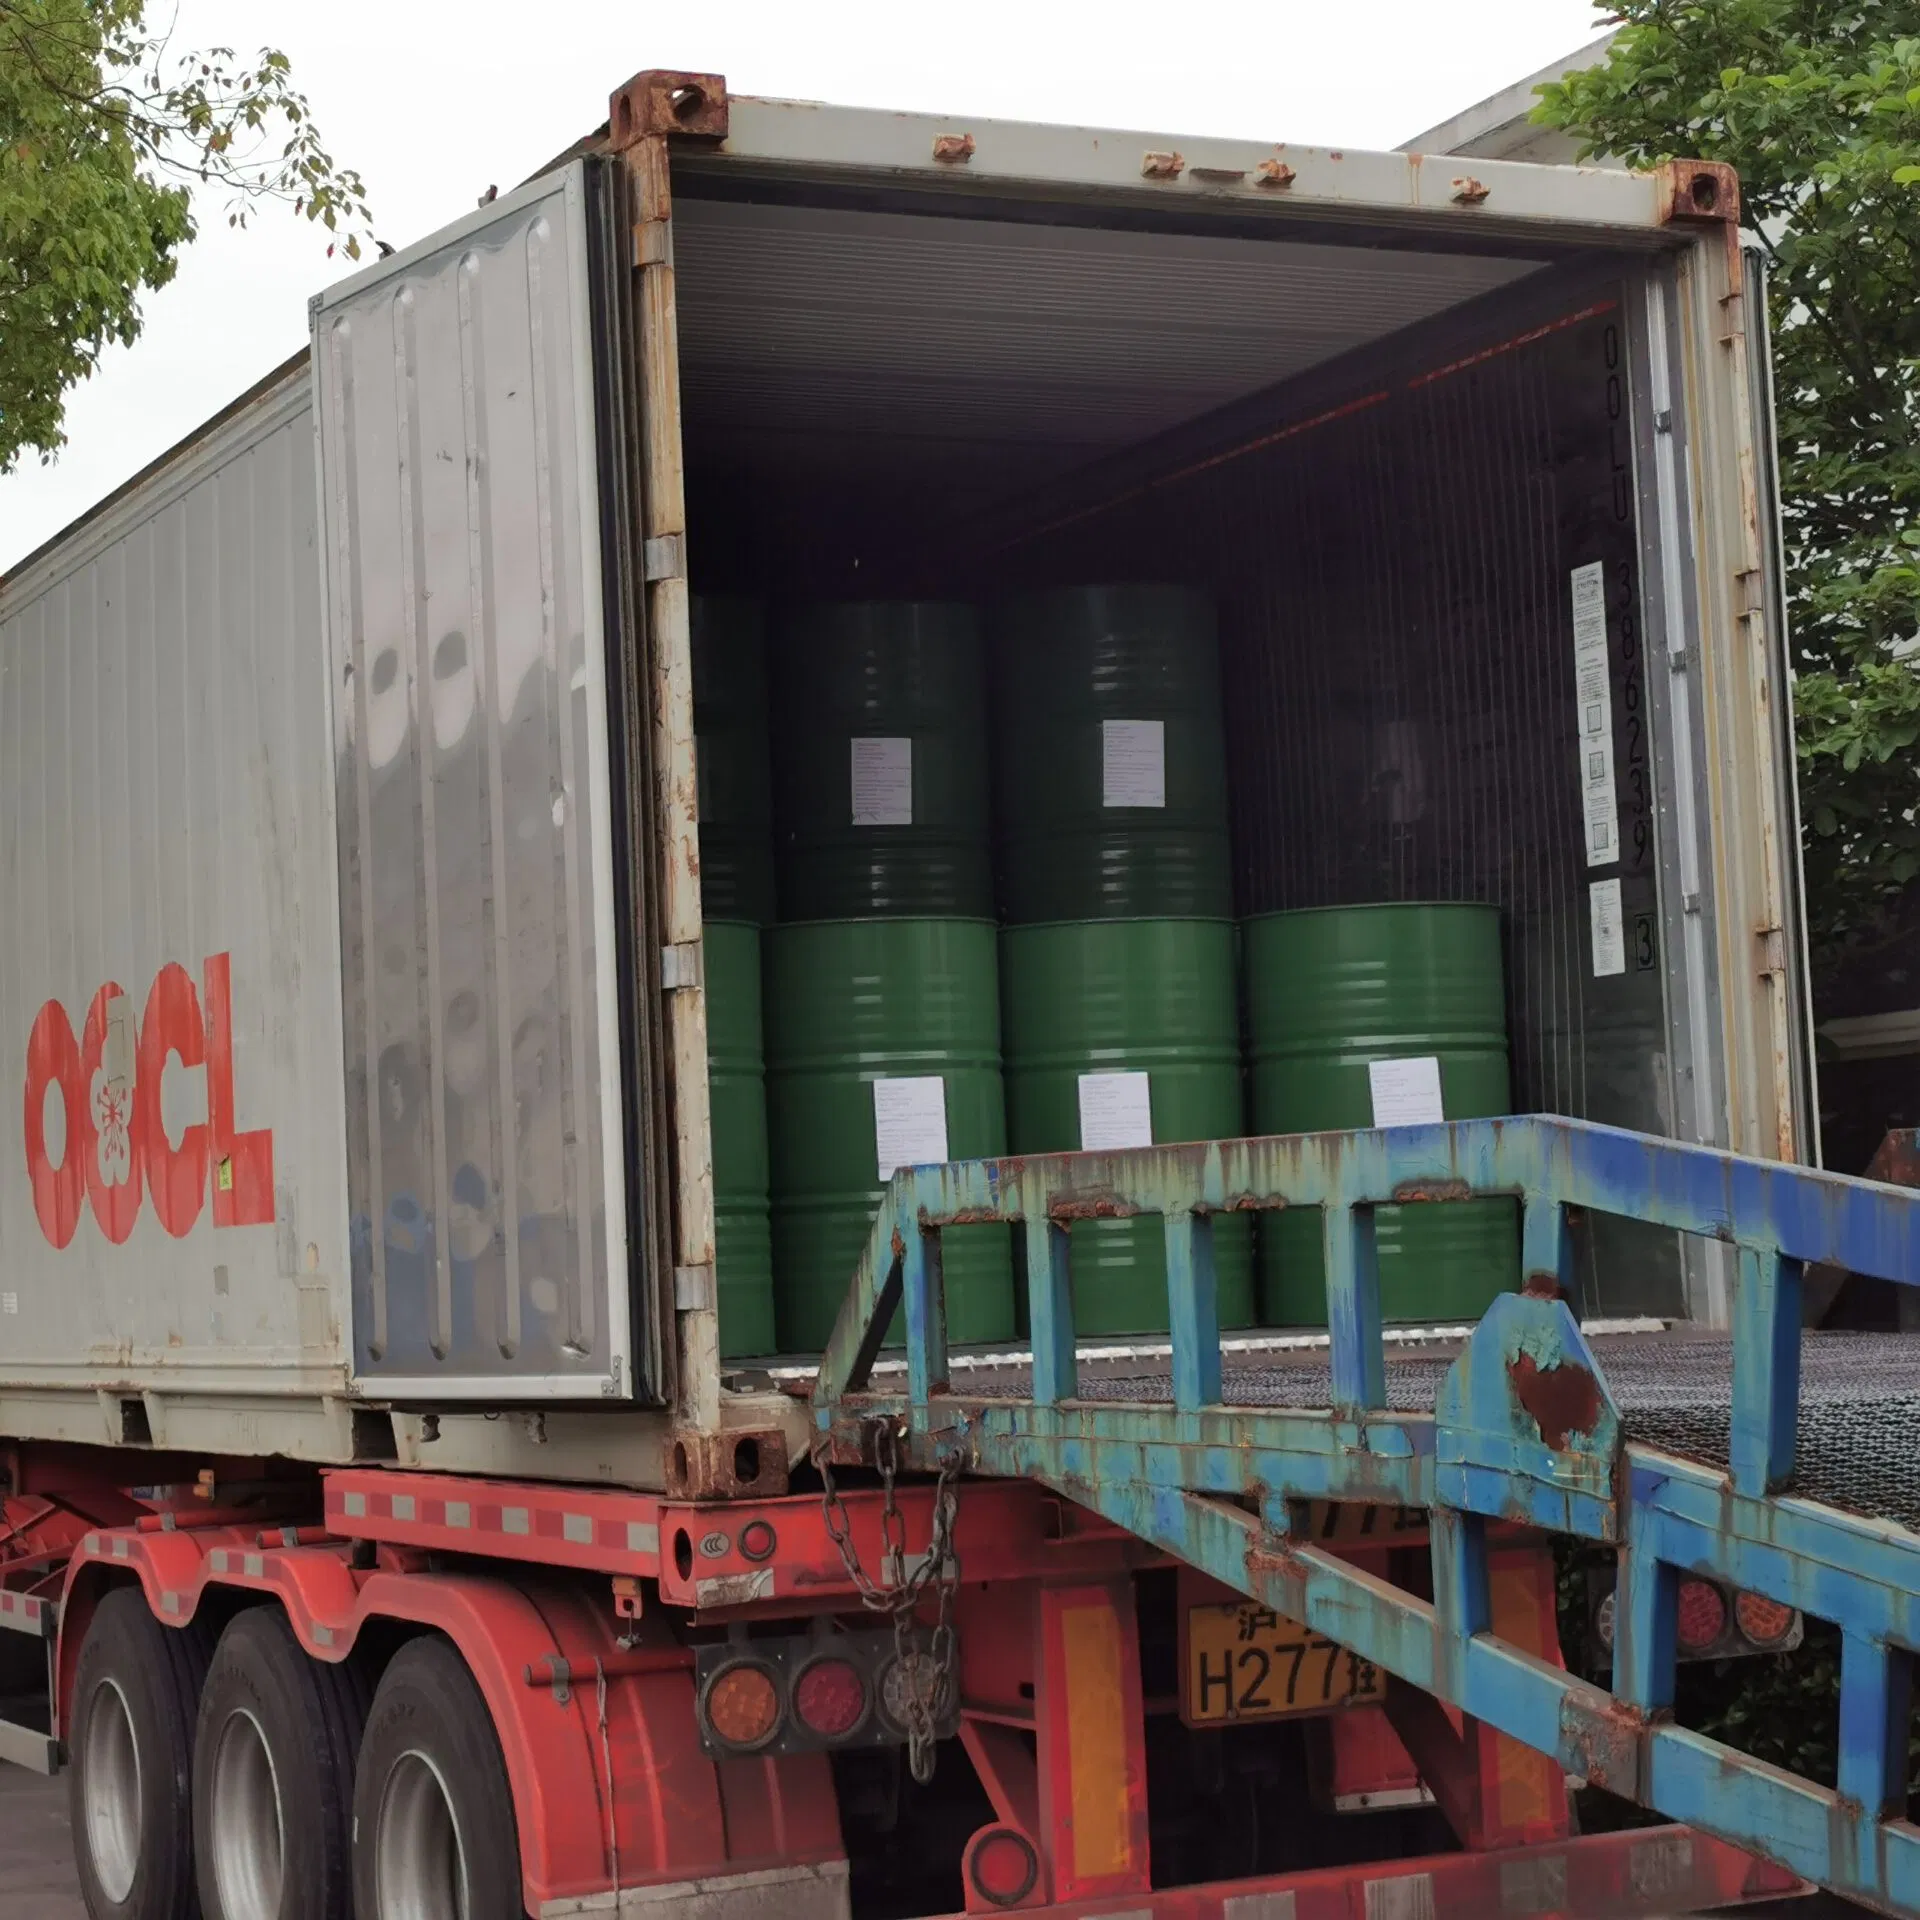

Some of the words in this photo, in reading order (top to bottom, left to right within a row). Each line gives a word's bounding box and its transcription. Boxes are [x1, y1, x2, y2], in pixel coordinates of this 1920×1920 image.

[1604, 324, 1628, 521] OOLU
[1637, 918, 1652, 966] 3
[25, 951, 275, 1250] OOCL
